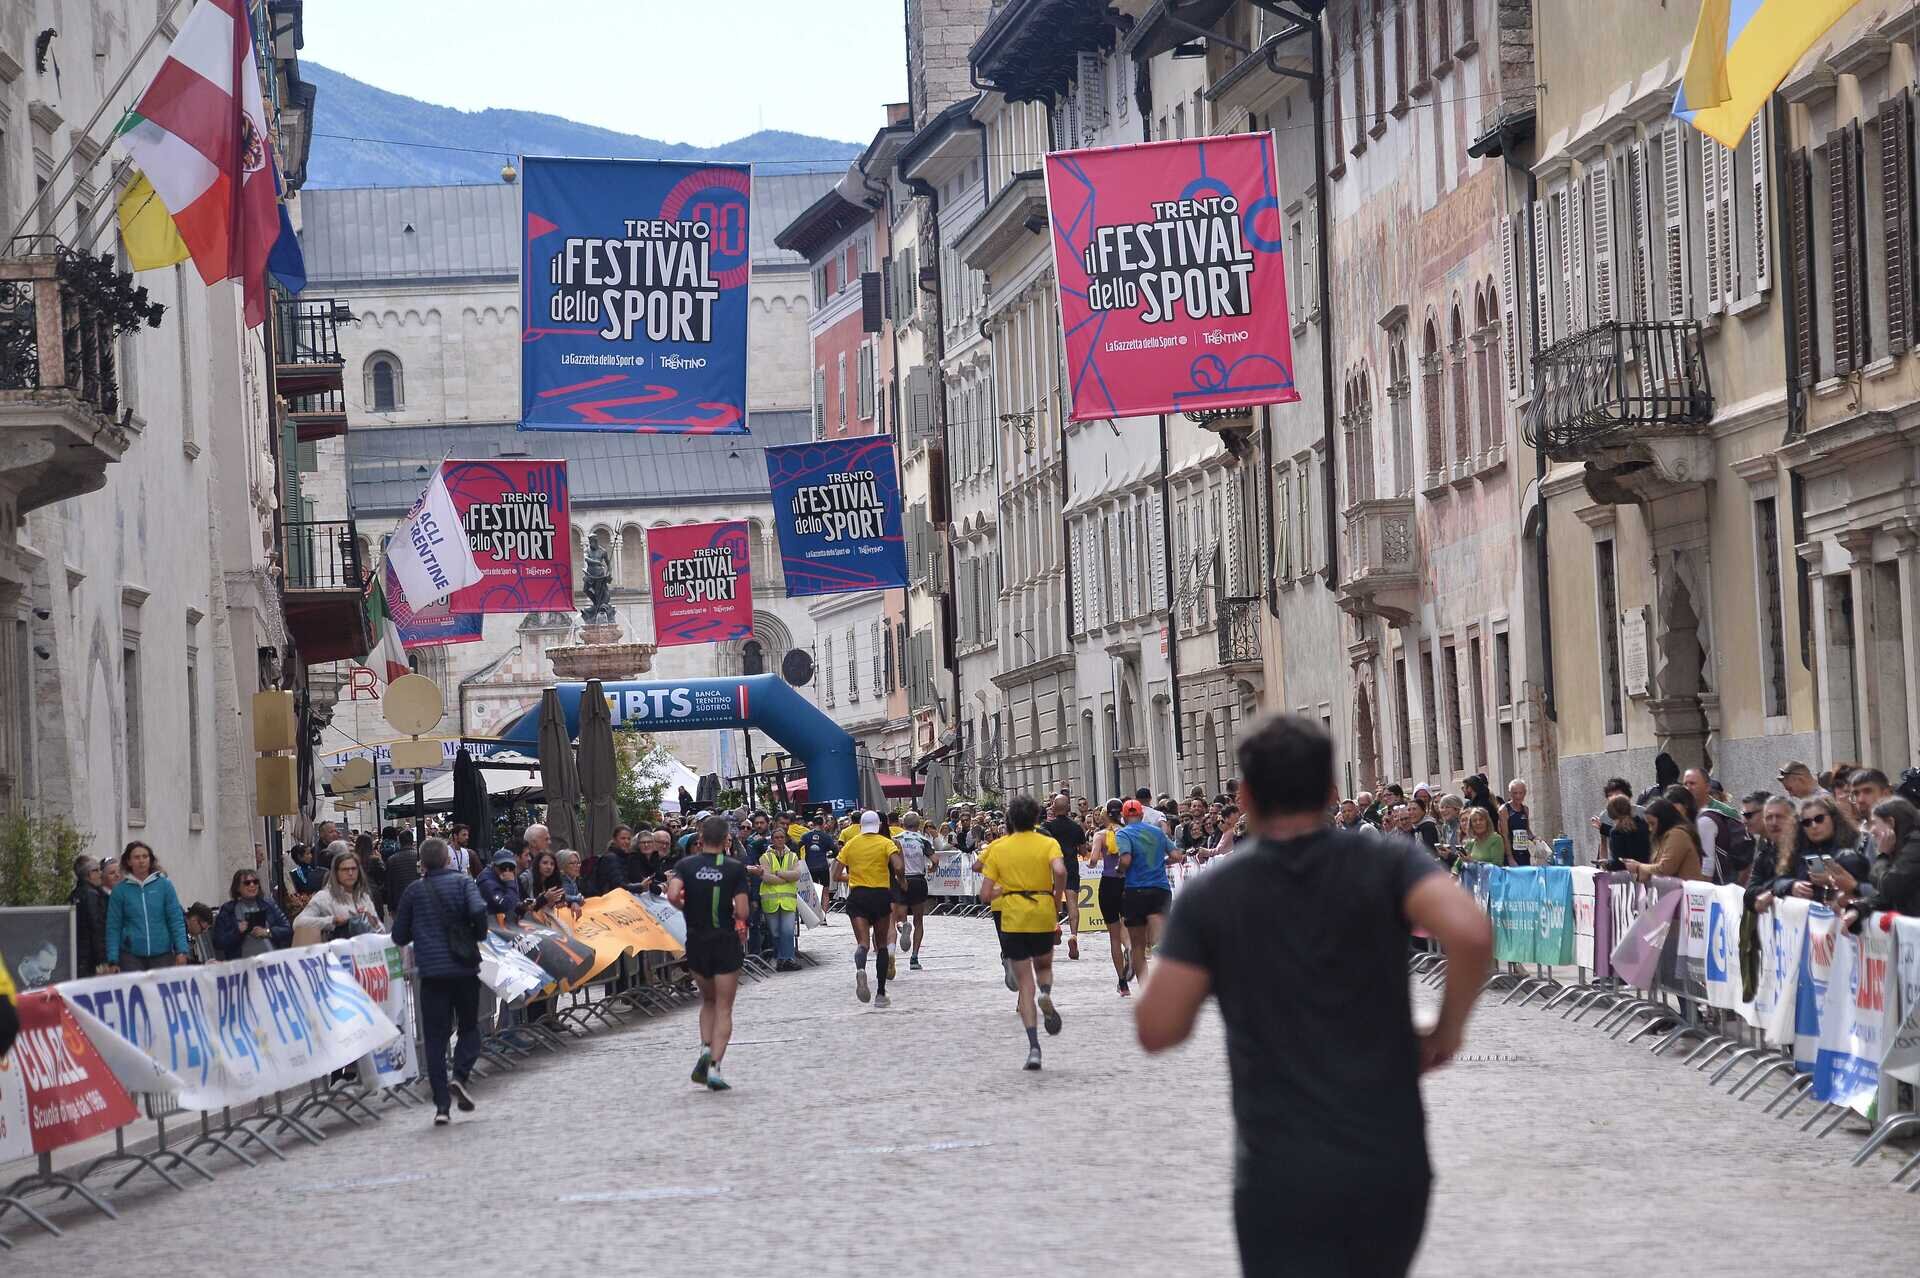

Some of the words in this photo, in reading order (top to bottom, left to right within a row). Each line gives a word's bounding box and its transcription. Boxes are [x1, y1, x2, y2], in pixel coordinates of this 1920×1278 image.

[1151, 196, 1238, 220] TRENTO
[624, 220, 710, 238] TRENTO
[1085, 242, 1097, 274] il
[1097, 216, 1252, 273] FESTIVAL
[551, 253, 562, 284] il
[566, 239, 719, 288] FESTIVAL
[1088, 276, 1137, 310] dello
[1138, 263, 1253, 323] SPORT
[551, 290, 599, 322] dello
[600, 289, 719, 341] SPORT
[1105, 341, 1114, 352] La
[1114, 338, 1143, 351] Gazzetta
[1143, 337, 1159, 349] dello
[1159, 336, 1178, 349] Sport
[1202, 330, 1249, 345] TRENTINO
[561, 354, 570, 365] La
[570, 353, 599, 366] Gazzetta
[600, 354, 616, 366] dello
[616, 354, 635, 368] Sport
[660, 354, 707, 370] TRENTINO
[826, 470, 874, 484] TRENTO
[501, 492, 548, 503] TRENTO
[792, 496, 799, 514] il
[798, 481, 883, 514] FESTIVAL
[419, 511, 444, 545] ACLI
[470, 503, 555, 530] FESTIVAL
[795, 515, 823, 535] dello
[822, 508, 885, 542] SPORT
[467, 532, 491, 551] ello
[491, 531, 556, 561] SPORT
[693, 546, 732, 558] TRENTO
[668, 555, 737, 581] FESTIVAL
[663, 582, 685, 598] dello
[686, 576, 738, 603] SPORT
[625, 687, 692, 720] BTS
[695, 690, 721, 698] BANCA
[695, 696, 732, 705] TRENTINO
[695, 702, 731, 712] SÜDTIROL
[695, 871, 723, 882] coop
[33, 1100, 60, 1131] Scuola
